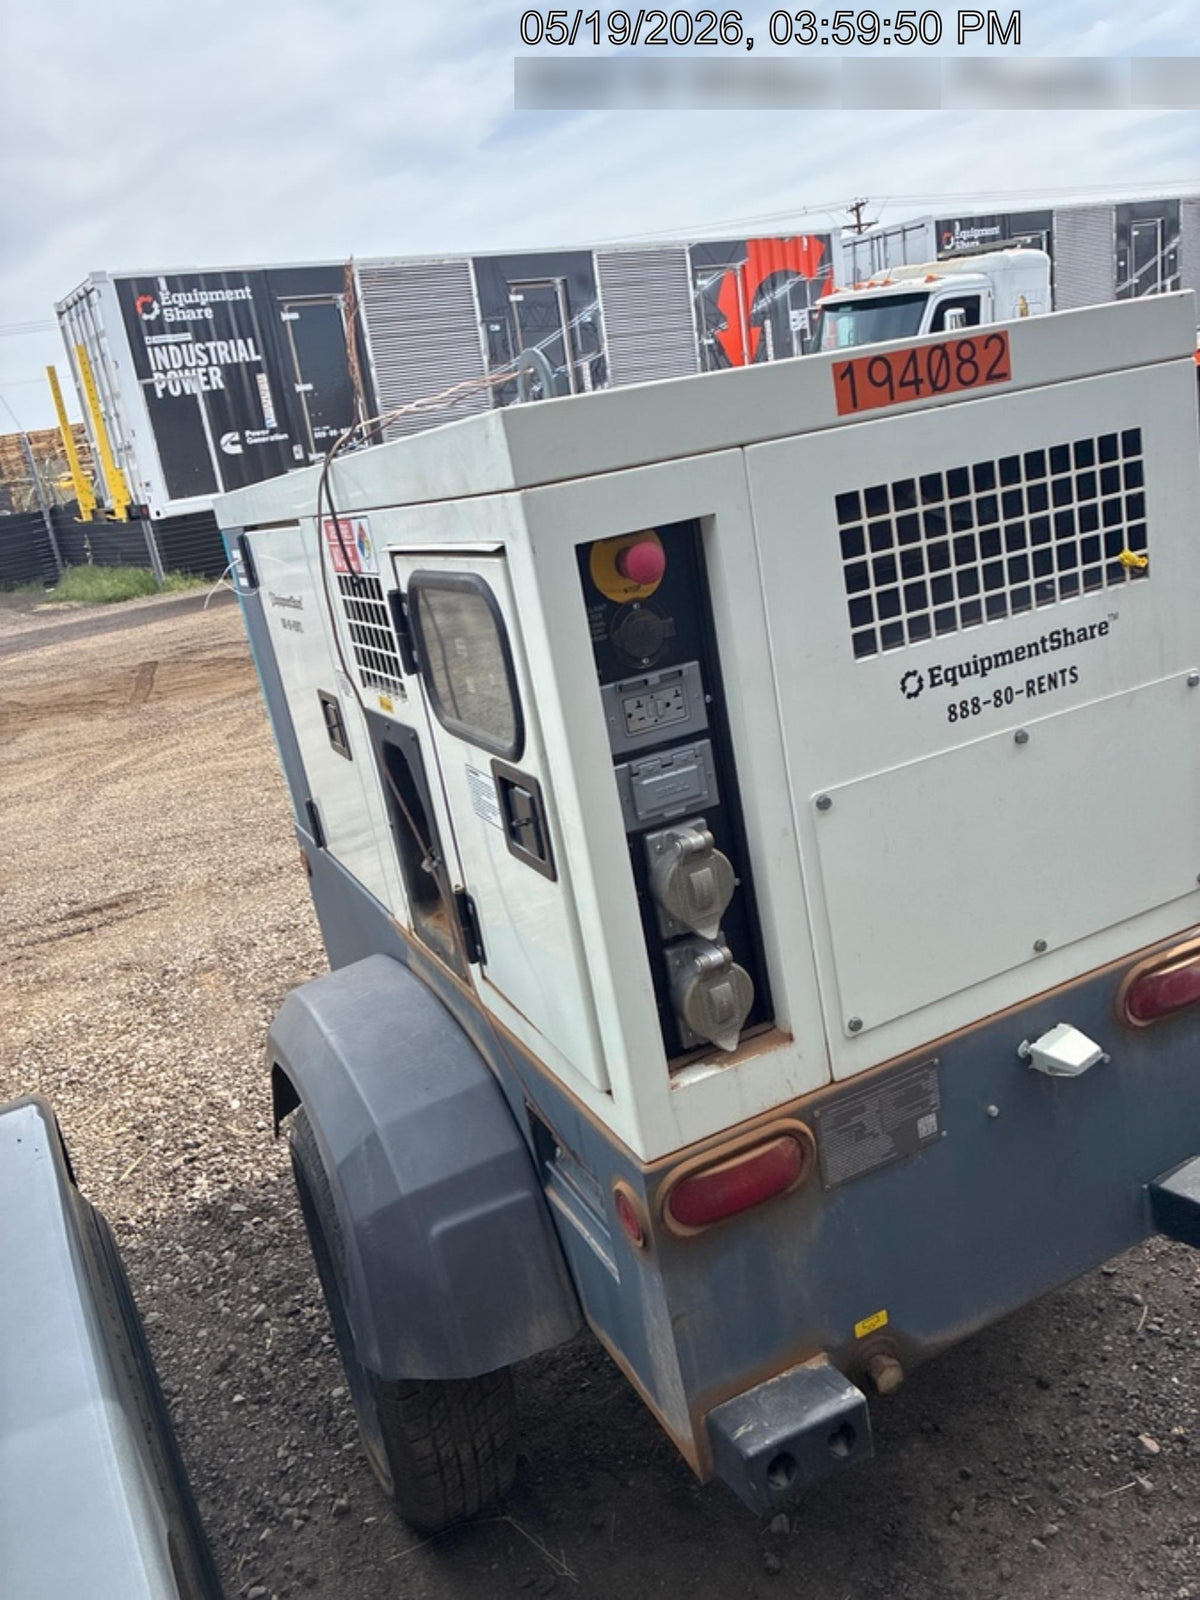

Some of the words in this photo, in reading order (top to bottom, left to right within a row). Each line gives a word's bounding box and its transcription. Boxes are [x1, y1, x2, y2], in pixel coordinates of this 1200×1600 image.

[160, 286, 253, 307] Equipment
[163, 307, 215, 322] Share
[146, 337, 262, 371] INDUSTRIAL
[839, 333, 1007, 409] 194082
[153, 366, 225, 399] POWER
[928, 619, 1110, 688] EquipmentShare
[947, 665, 1079, 722] 888-80-RENTS
